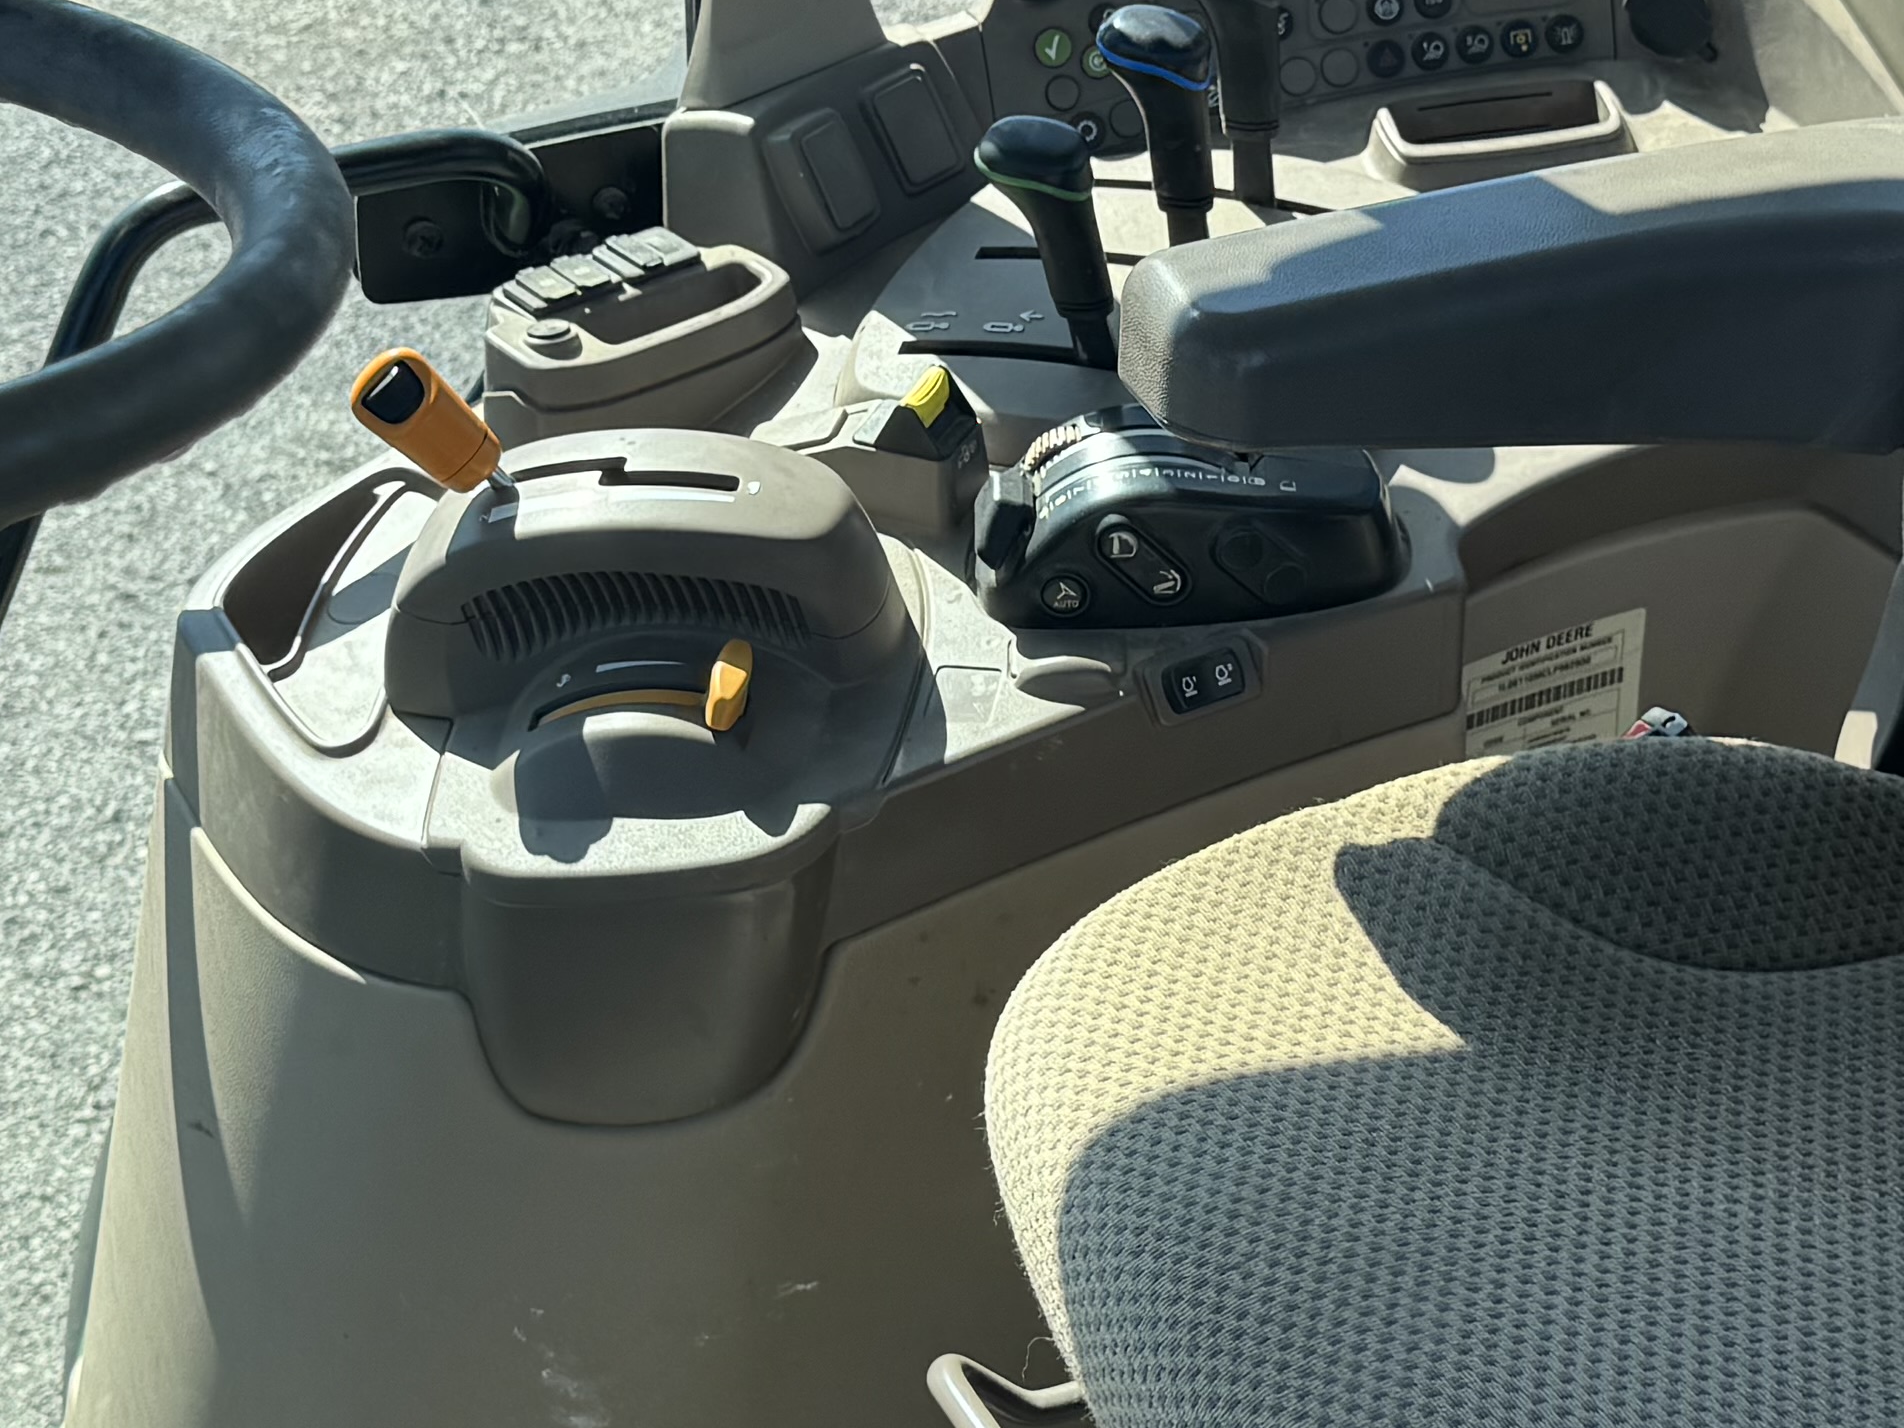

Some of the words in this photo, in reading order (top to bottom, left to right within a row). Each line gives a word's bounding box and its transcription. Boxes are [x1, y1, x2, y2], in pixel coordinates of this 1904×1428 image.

[1052, 598, 1080, 609] AUTO
[1501, 640, 1541, 665] JOHN
[1546, 623, 1594, 650] DEERE
